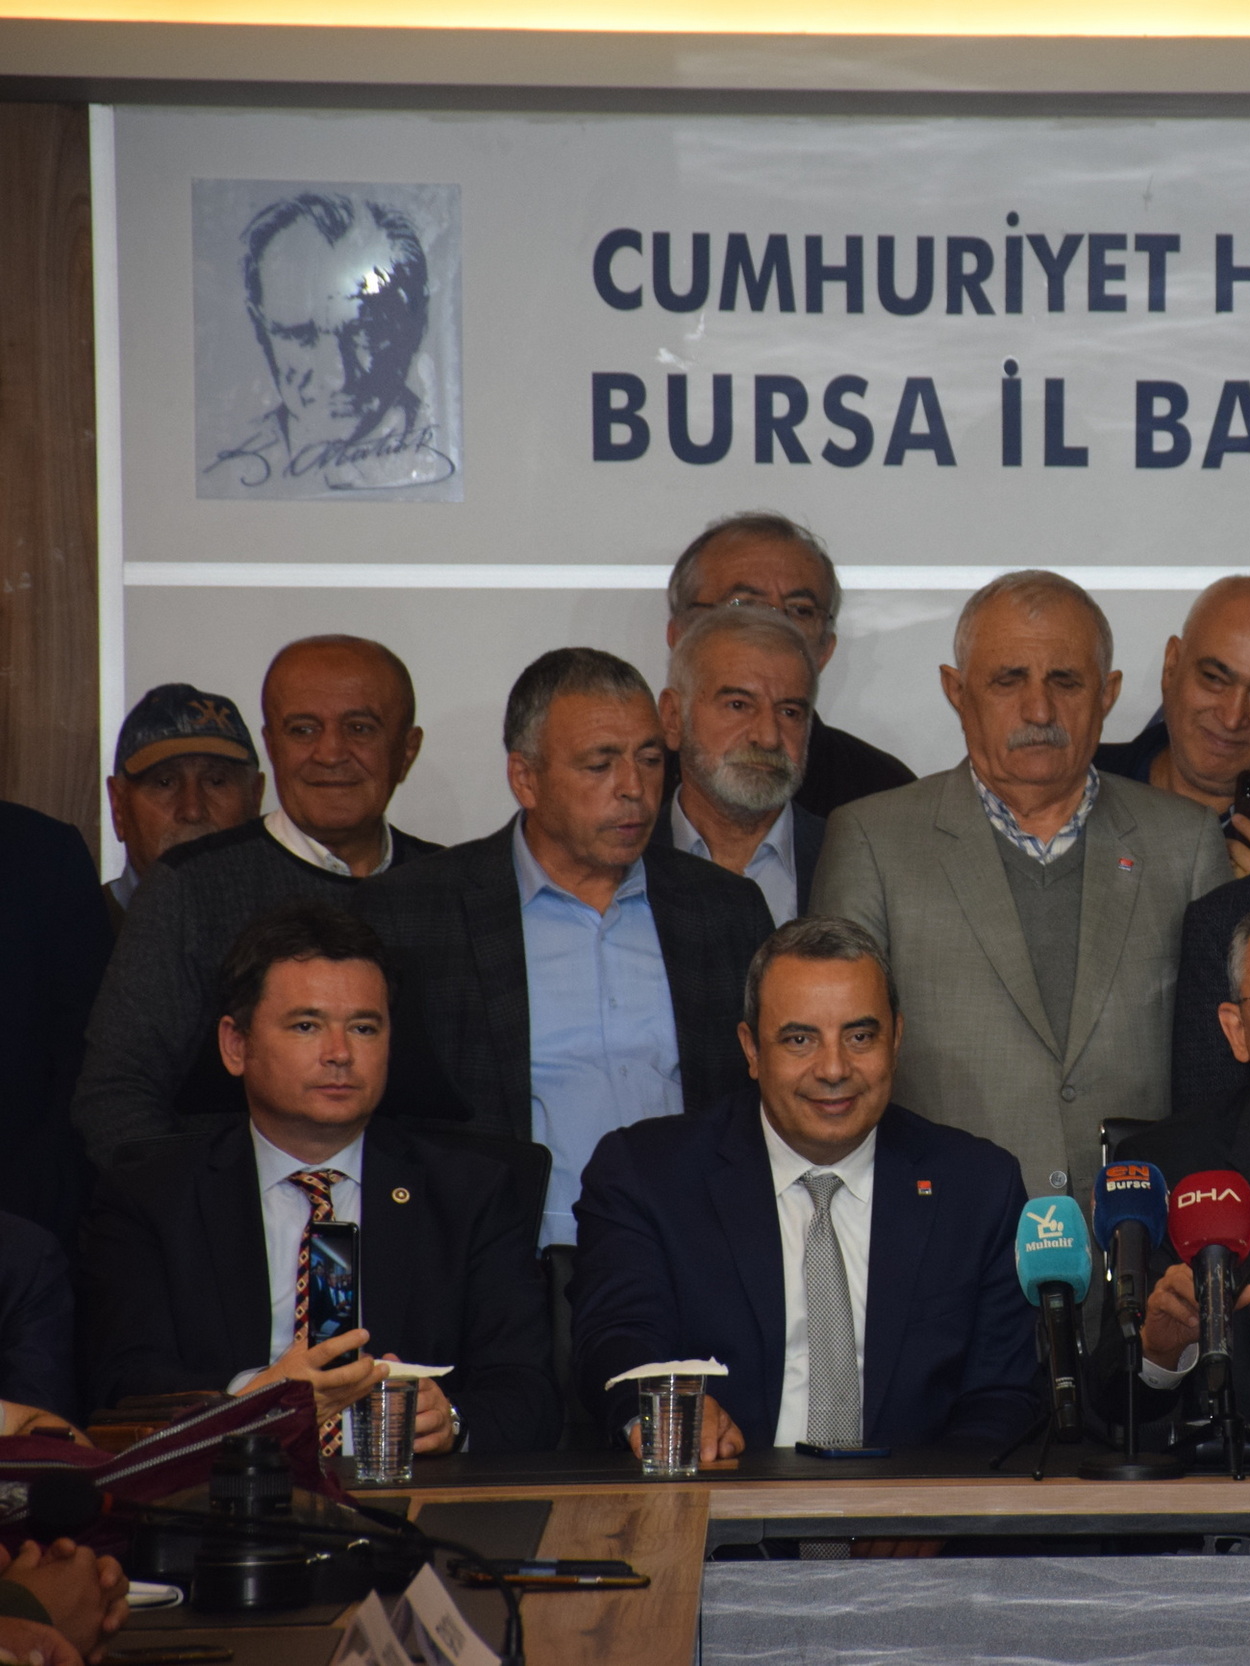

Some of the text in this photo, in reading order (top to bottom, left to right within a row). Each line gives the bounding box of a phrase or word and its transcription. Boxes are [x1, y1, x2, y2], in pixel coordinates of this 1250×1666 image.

[592, 210, 1181, 316] CUMHURİYET
[591, 371, 958, 469] BURSA
[1001, 356, 1090, 468] İL
[1106, 1181, 1151, 1192] Bursa
[1178, 1188, 1242, 1208] DHA
[1025, 1237, 1074, 1252] Muhalif
